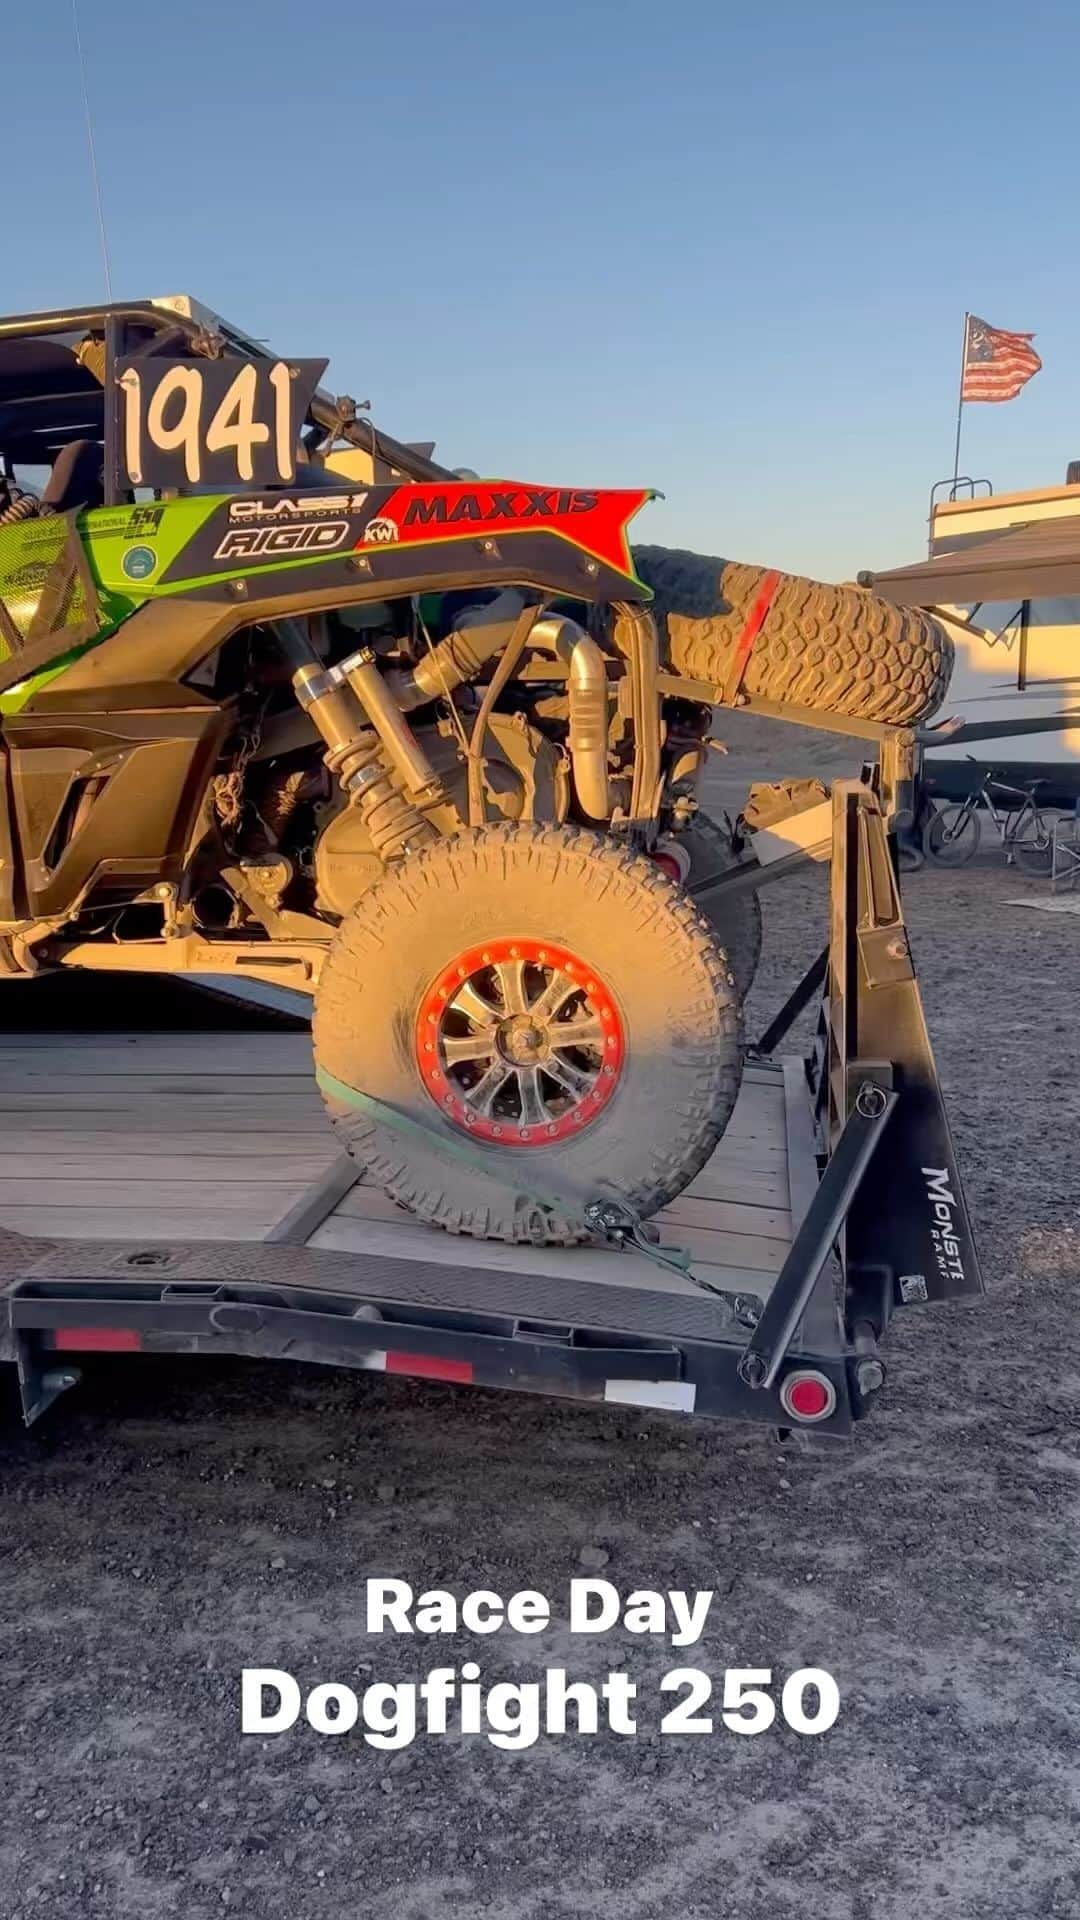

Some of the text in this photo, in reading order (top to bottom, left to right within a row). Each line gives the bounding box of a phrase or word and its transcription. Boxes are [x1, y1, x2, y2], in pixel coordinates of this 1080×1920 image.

[119, 361, 293, 484] 1941
[228, 506, 362, 524] MOTORSPORTS
[403, 490, 599, 525] MAXXIS
[213, 521, 350, 560] RIGID
